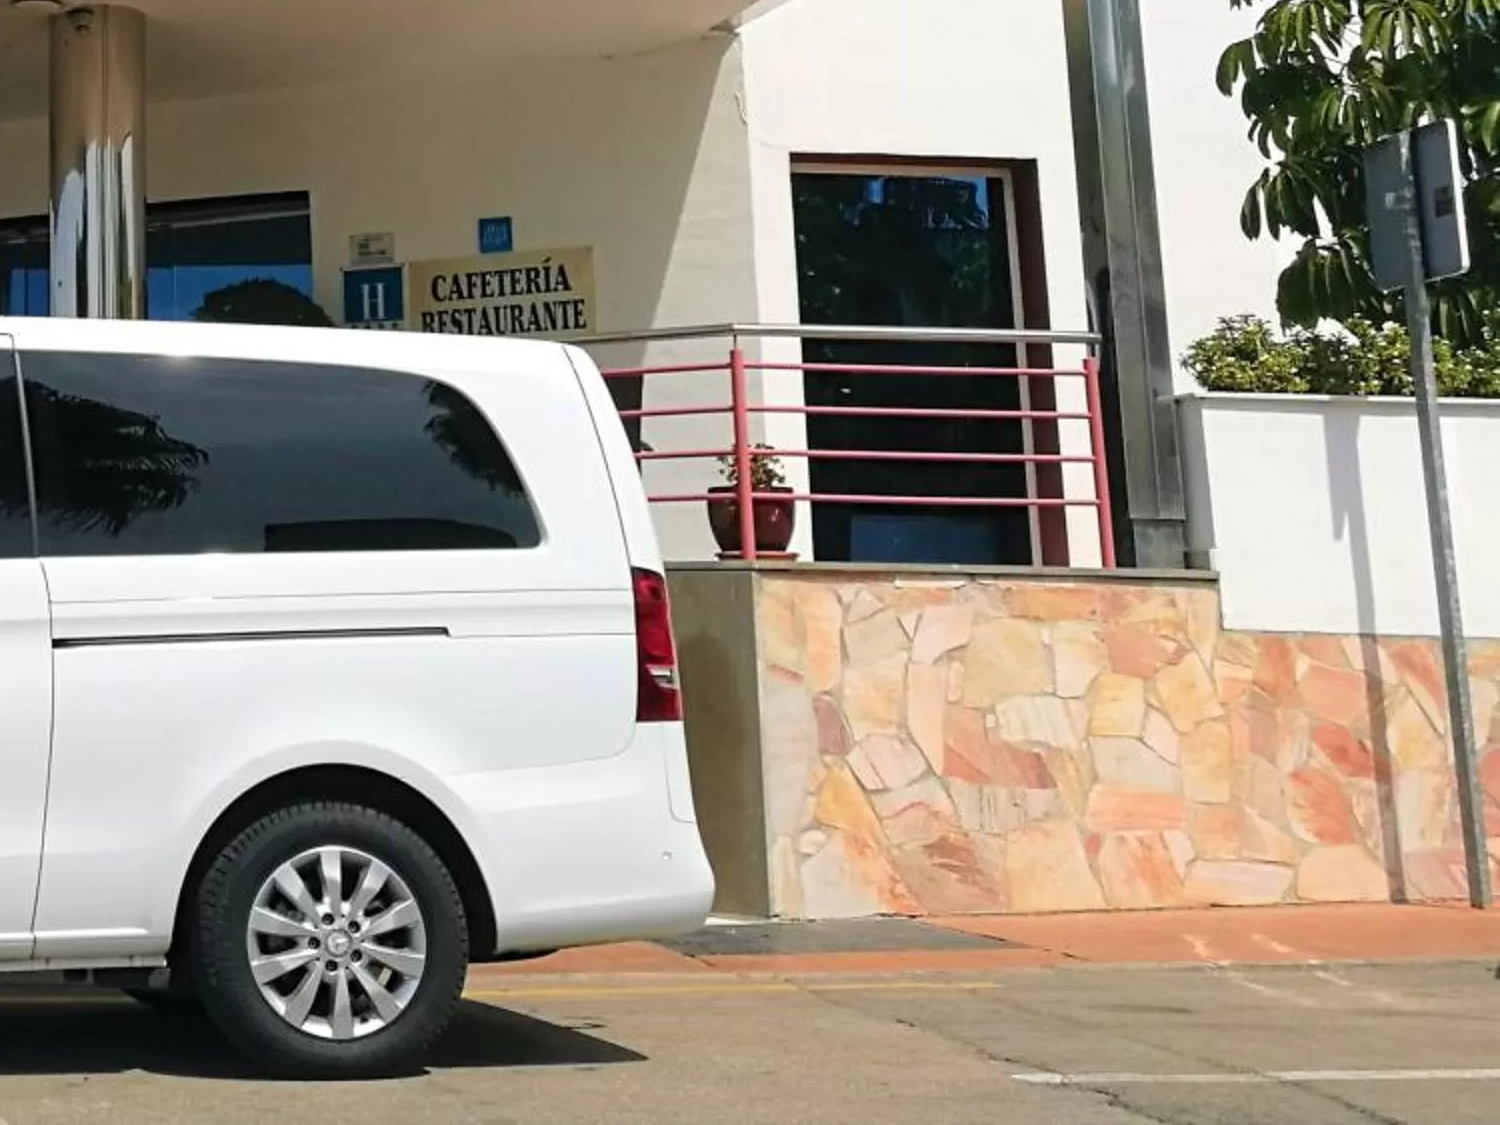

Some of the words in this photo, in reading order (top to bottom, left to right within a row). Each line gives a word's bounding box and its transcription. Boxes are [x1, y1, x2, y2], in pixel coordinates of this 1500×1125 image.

[430, 258, 572, 302] CAFETERÍA
[360, 283, 386, 321] H
[420, 298, 588, 336] RESTAURANTE
